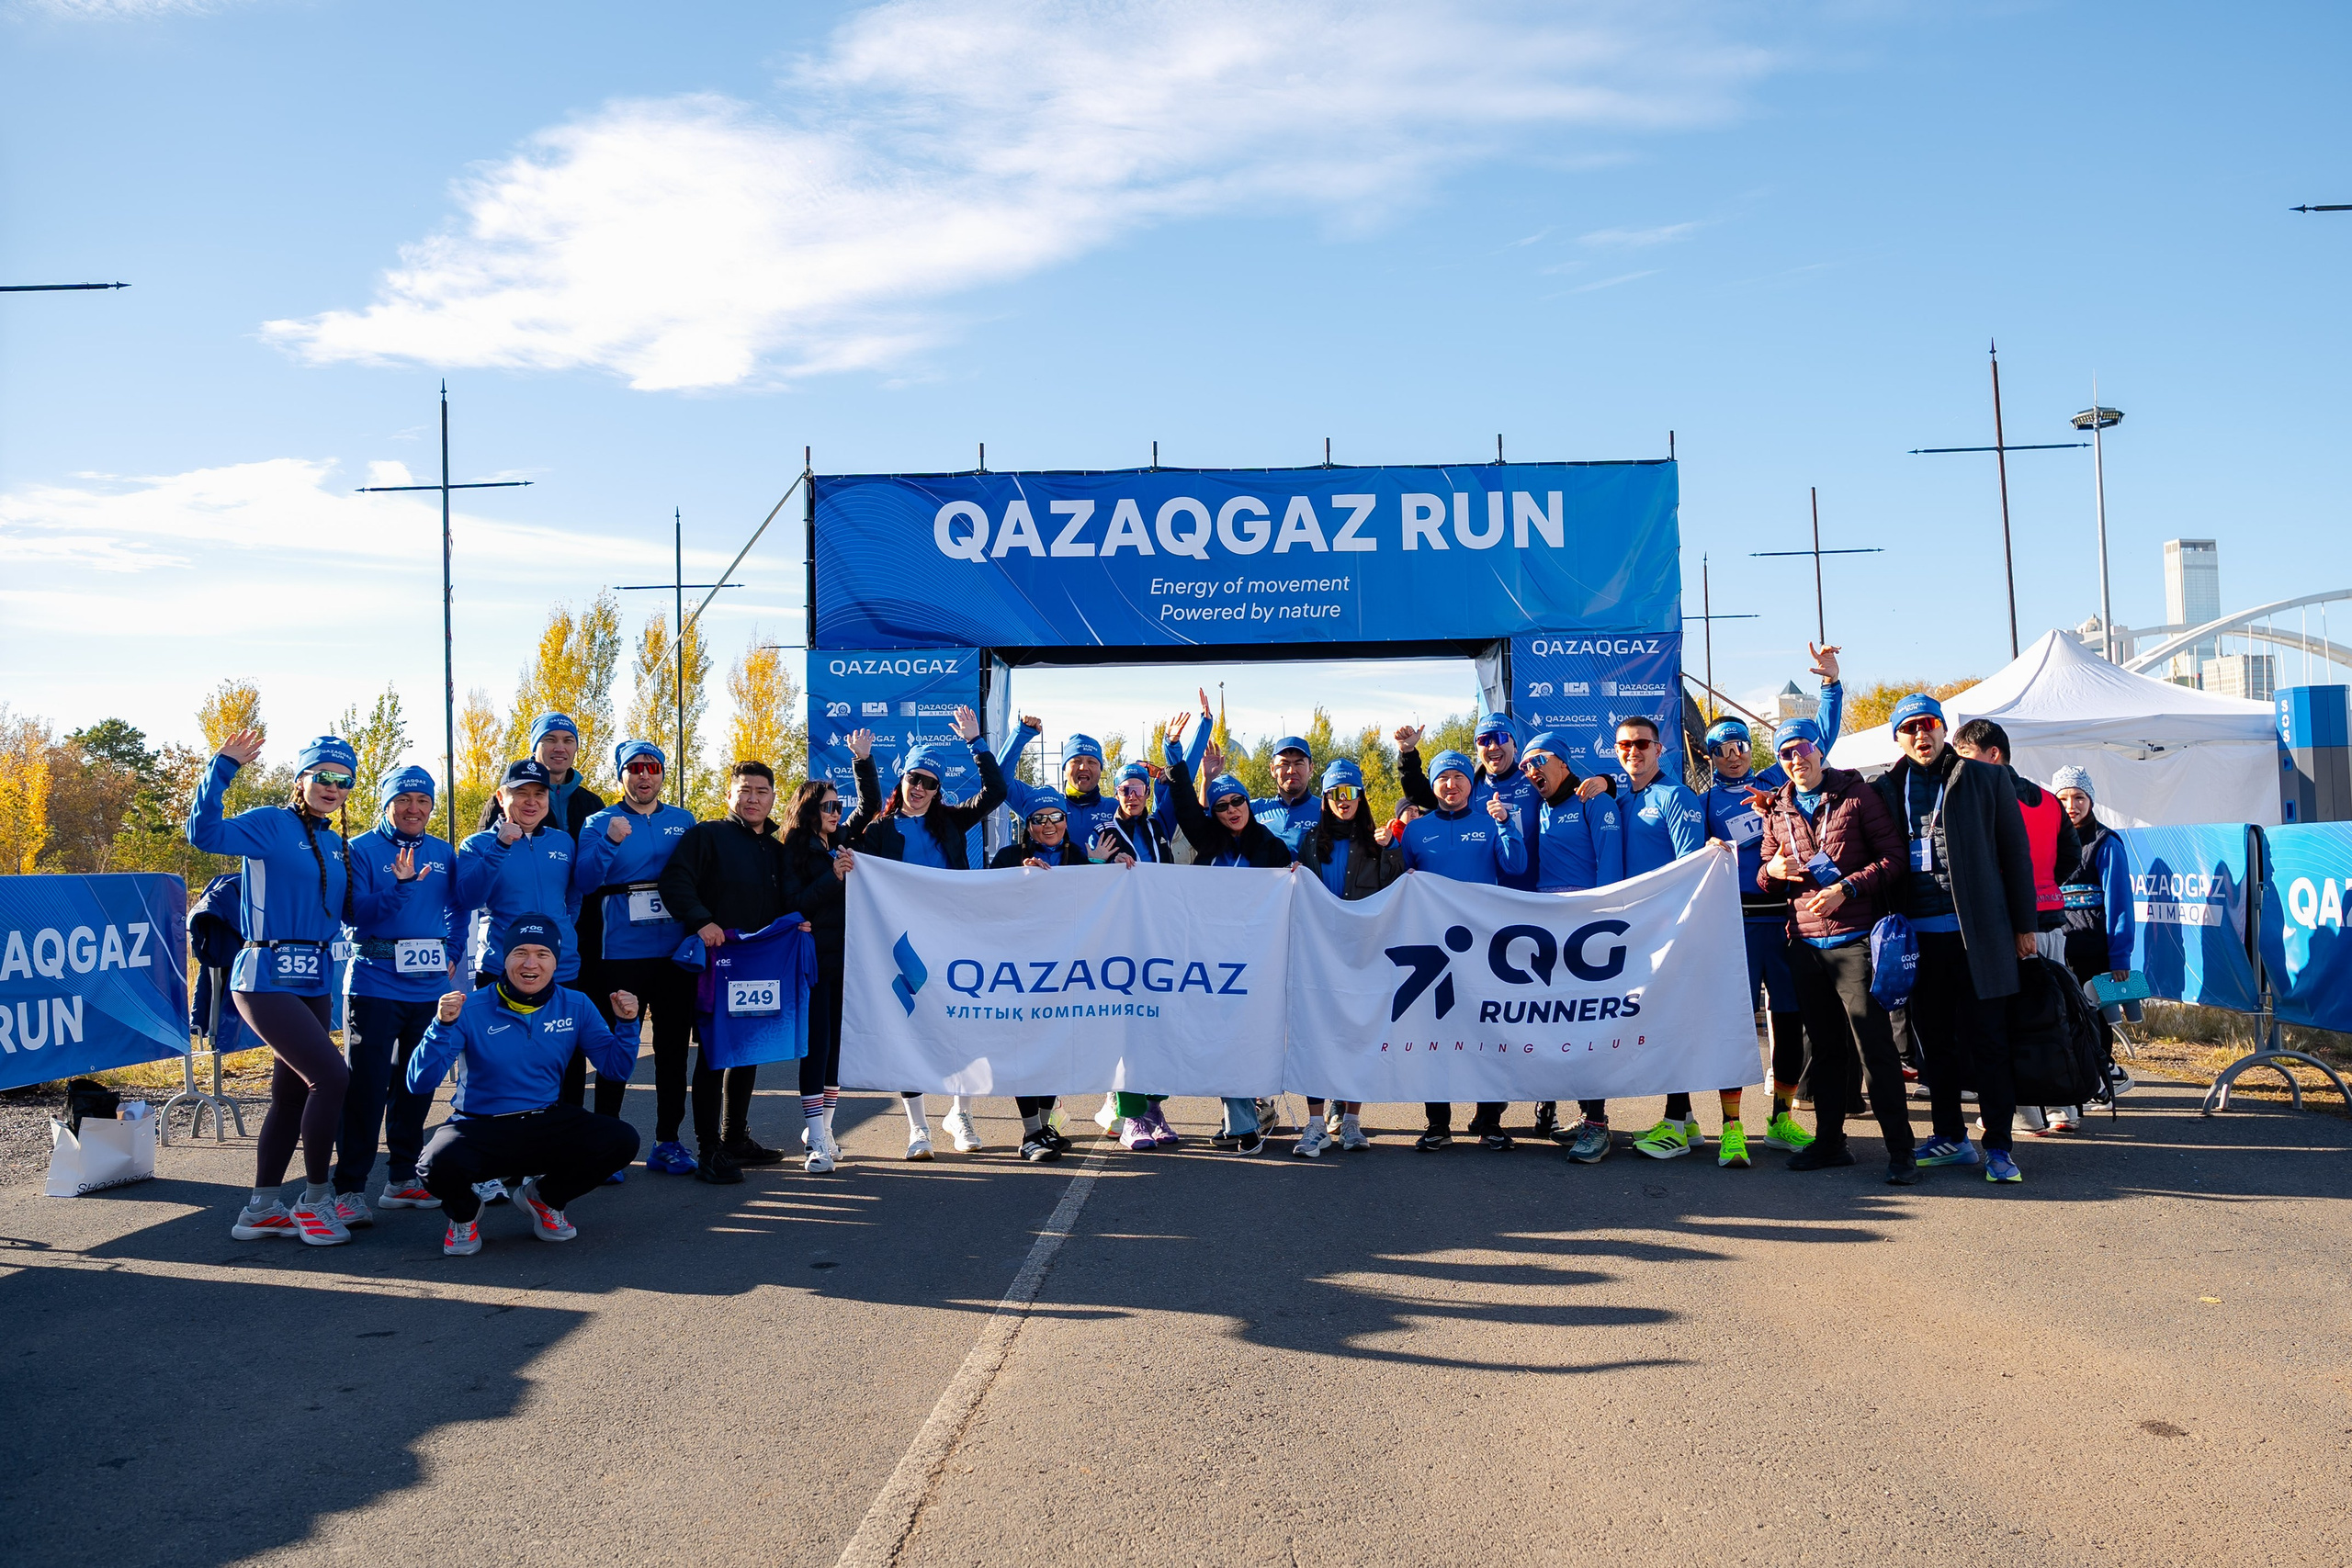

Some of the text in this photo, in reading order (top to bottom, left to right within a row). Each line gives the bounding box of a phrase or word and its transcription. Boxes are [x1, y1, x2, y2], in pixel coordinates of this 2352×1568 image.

[933, 491, 1565, 563] QAZAQGAZ RUN
[1150, 576, 1351, 598] Energy of movement
[1160, 603, 1341, 623] Powered by nature
[1532, 639, 1660, 657] QAZAQGAZ
[829, 659, 958, 677] QAZAQGAZ
[1563, 682, 1590, 694] ICA
[861, 702, 888, 713] ICA
[2281, 699, 2290, 743] SOS
[915, 734, 964, 743] QAZAQGAZ
[433, 862, 445, 870] QG
[2129, 873, 2226, 900] AZAQGAZ
[650, 897, 662, 913] 5
[2146, 905, 2199, 923] AIMAQ
[0, 922, 152, 981] AQGAZ
[404, 949, 441, 966] 205
[1487, 919, 1631, 987] QG
[277, 954, 319, 975] 352
[1903, 962, 1917, 970] UN
[946, 956, 1249, 999] QAZAQGAZ
[736, 989, 774, 1006] 249
[945, 1003, 1160, 1022] ҰЛТТЫҚ КОМПАНИЯСЫ
[1479, 993, 1641, 1024] RUNNERS
[557, 1017, 573, 1028] QG
[1381, 1034, 1646, 1054] RUNNING CLUB
